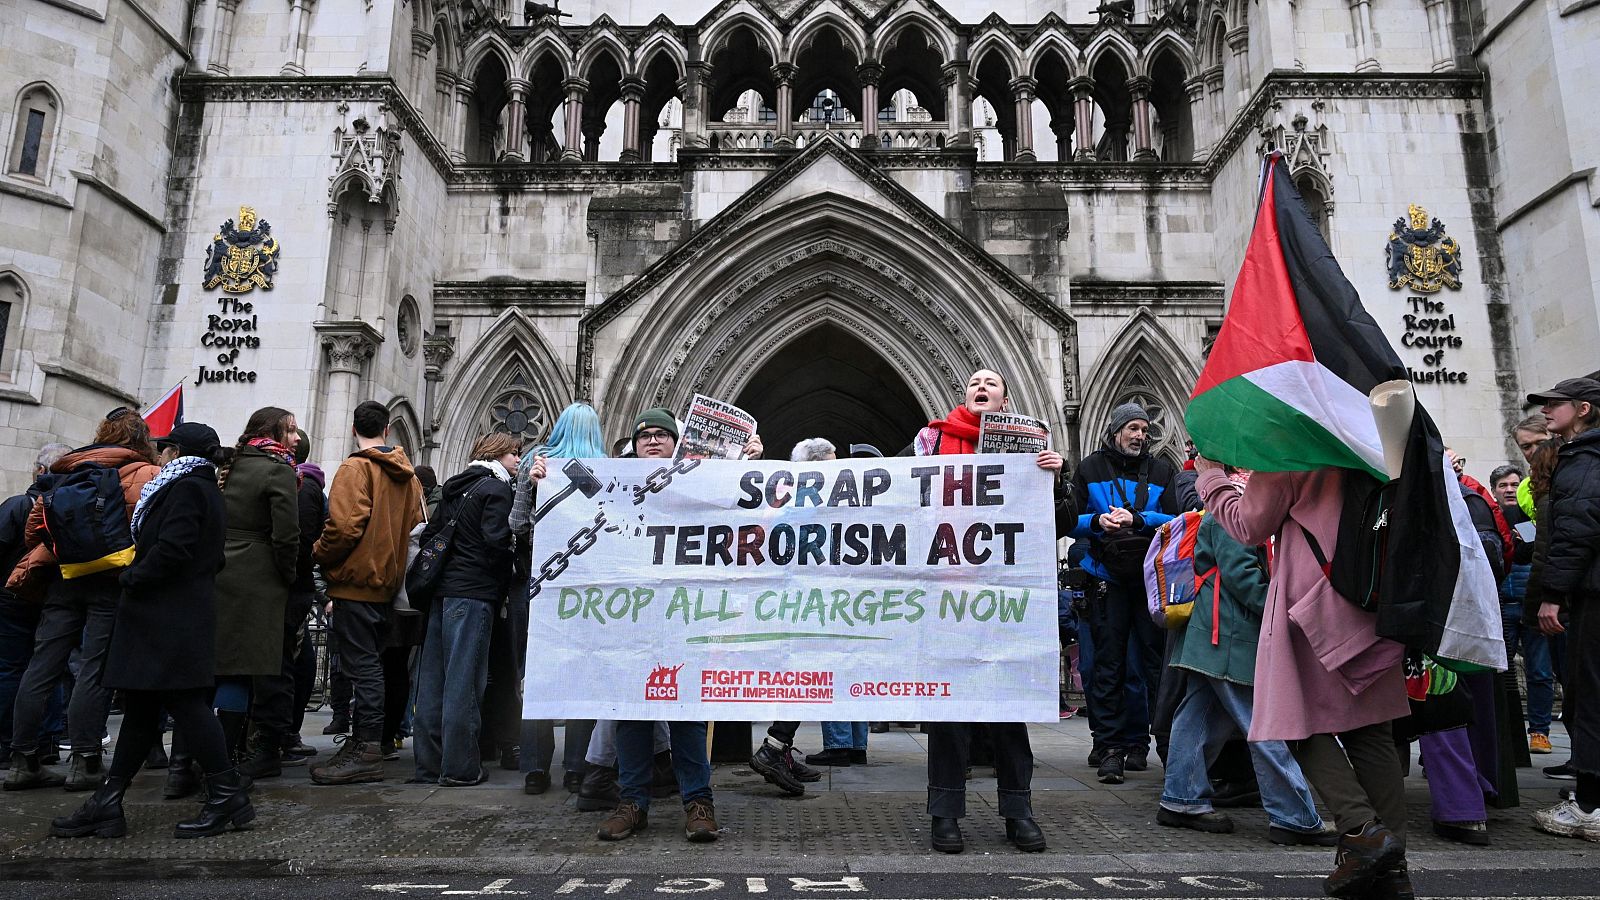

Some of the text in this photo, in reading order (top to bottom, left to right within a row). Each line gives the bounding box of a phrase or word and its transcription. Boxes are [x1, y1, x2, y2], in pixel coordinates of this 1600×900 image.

[217, 298, 253, 314] The
[1407, 296, 1445, 313] The
[207, 314, 258, 333] Royal
[1402, 314, 1456, 333] Royal
[201, 332, 261, 349] Courts
[1401, 332, 1463, 349] Courts
[217, 349, 240, 365] of
[1423, 350, 1445, 367] of
[194, 366, 257, 387] Justice
[693, 404, 713, 414] FIGHT
[695, 396, 722, 411] FIGHT
[690, 414, 708, 425] RISE
[708, 420, 719, 428] UP
[719, 424, 750, 440] AGAINST
[984, 414, 1013, 424] FIGHT
[688, 420, 720, 437] RACISM
[983, 441, 1018, 451] RACISM
[984, 433, 1047, 447] RISE UP AGAINST
[739, 465, 1004, 509] SCRAP THE
[647, 522, 1024, 566] TERRORISM ACT
[557, 587, 1030, 626] DROP ALL CHARGES NOW
[701, 670, 834, 686] FIGHT RACISM!
[647, 686, 677, 698] RCG
[701, 686, 834, 699] FIGHT IMPERIALISM!
[850, 681, 951, 697] @RCGFRFI
